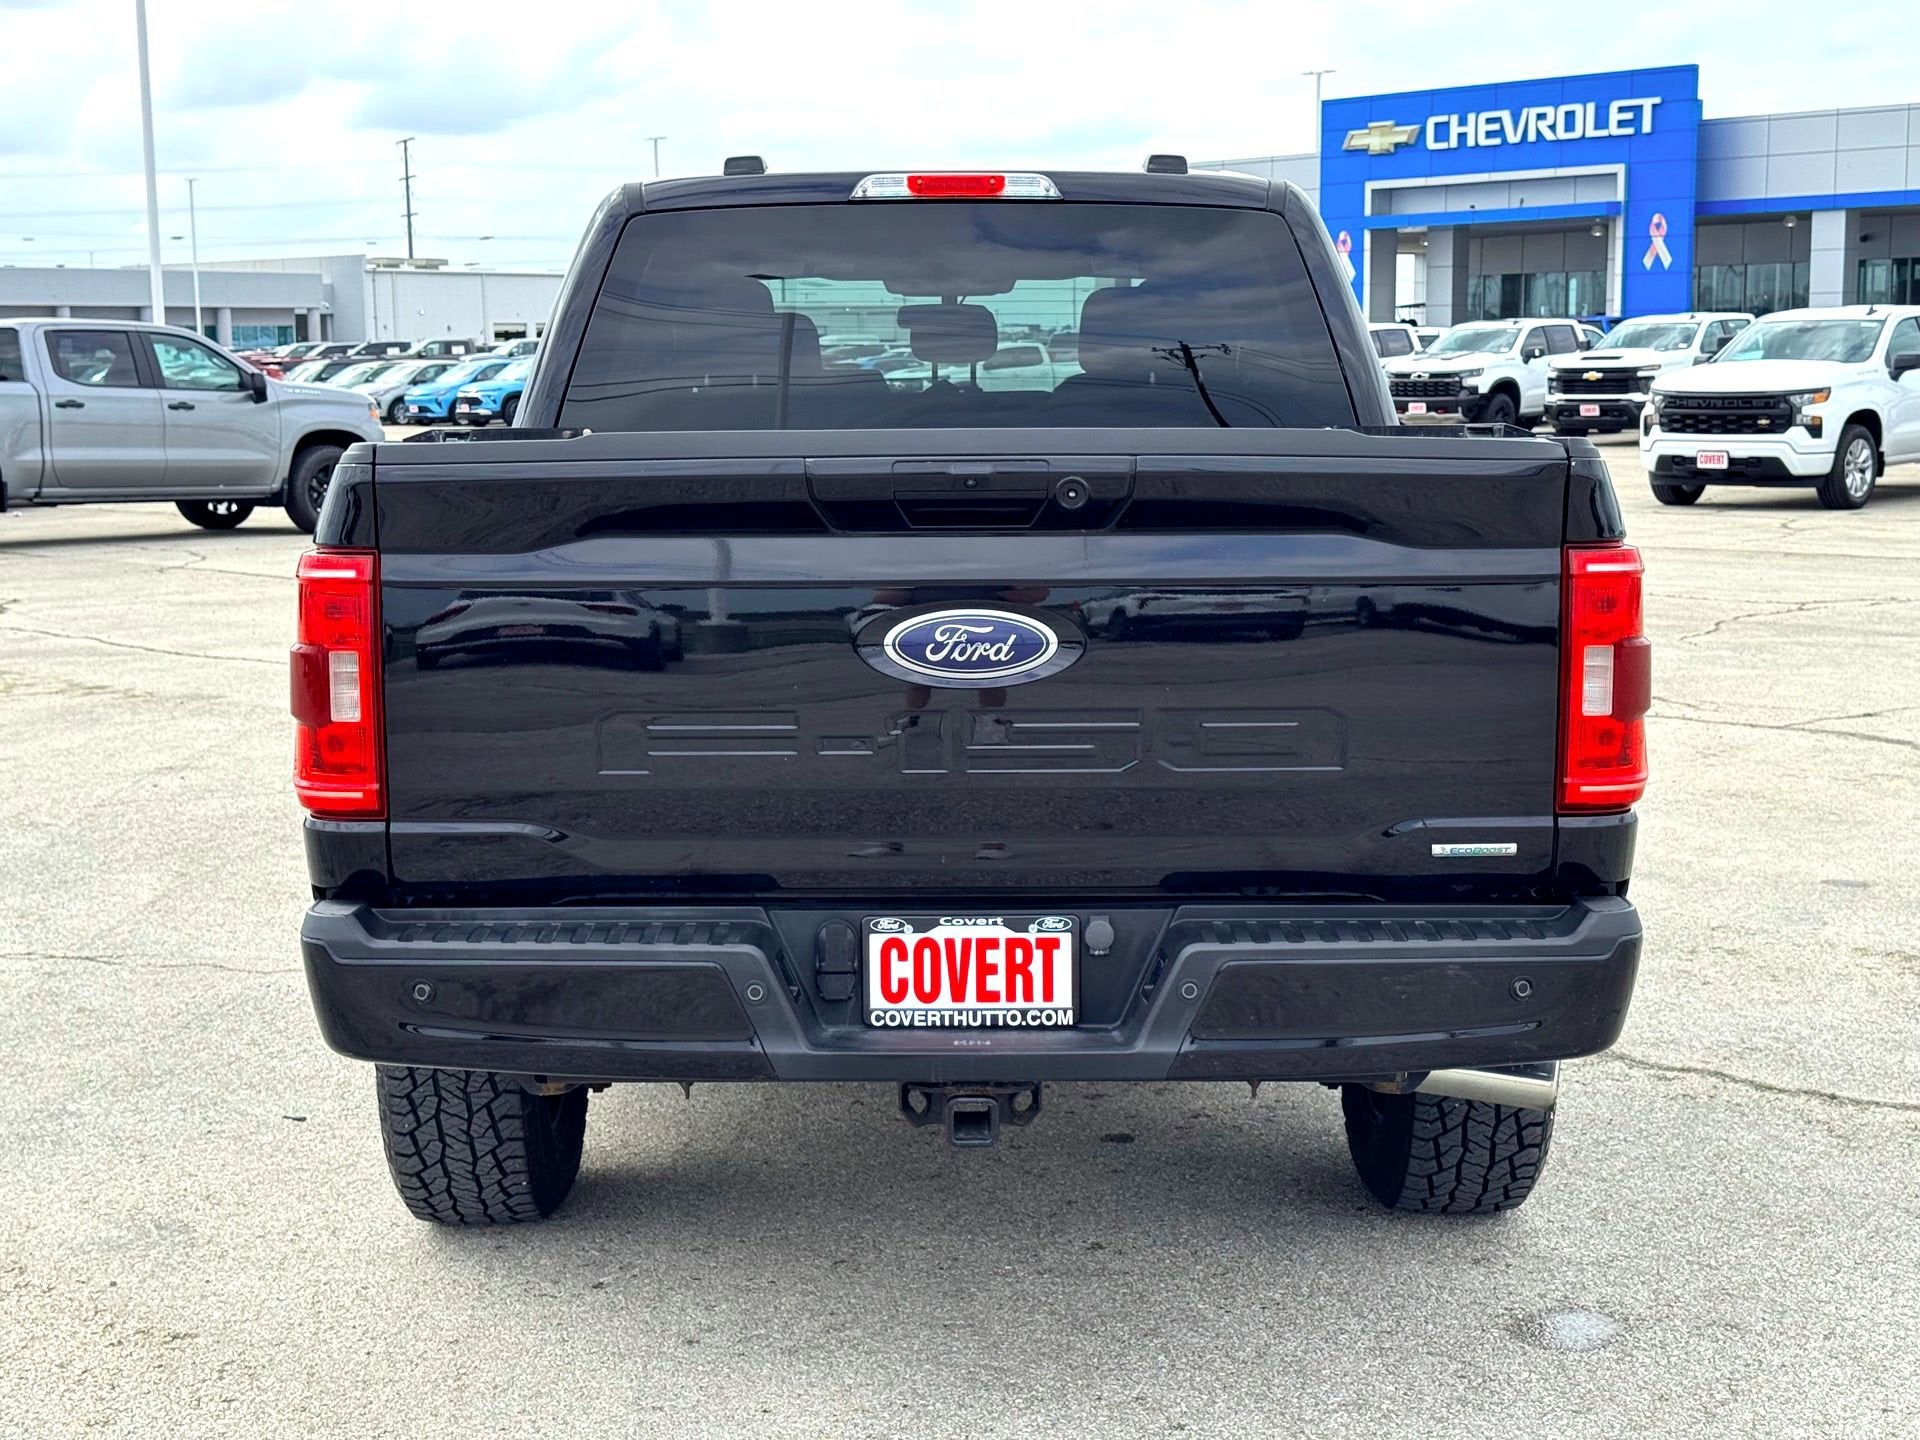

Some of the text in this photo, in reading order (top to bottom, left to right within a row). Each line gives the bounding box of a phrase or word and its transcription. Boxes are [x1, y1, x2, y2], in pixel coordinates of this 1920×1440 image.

[1426, 96, 1662, 150] CHEVROLET
[1699, 454, 1725, 466] COVERT
[925, 624, 1017, 662] Ford
[939, 916, 1004, 926] Covert
[880, 937, 1060, 1004] COVERT
[870, 1010, 1073, 1026] COVERTHUTTO.COM
